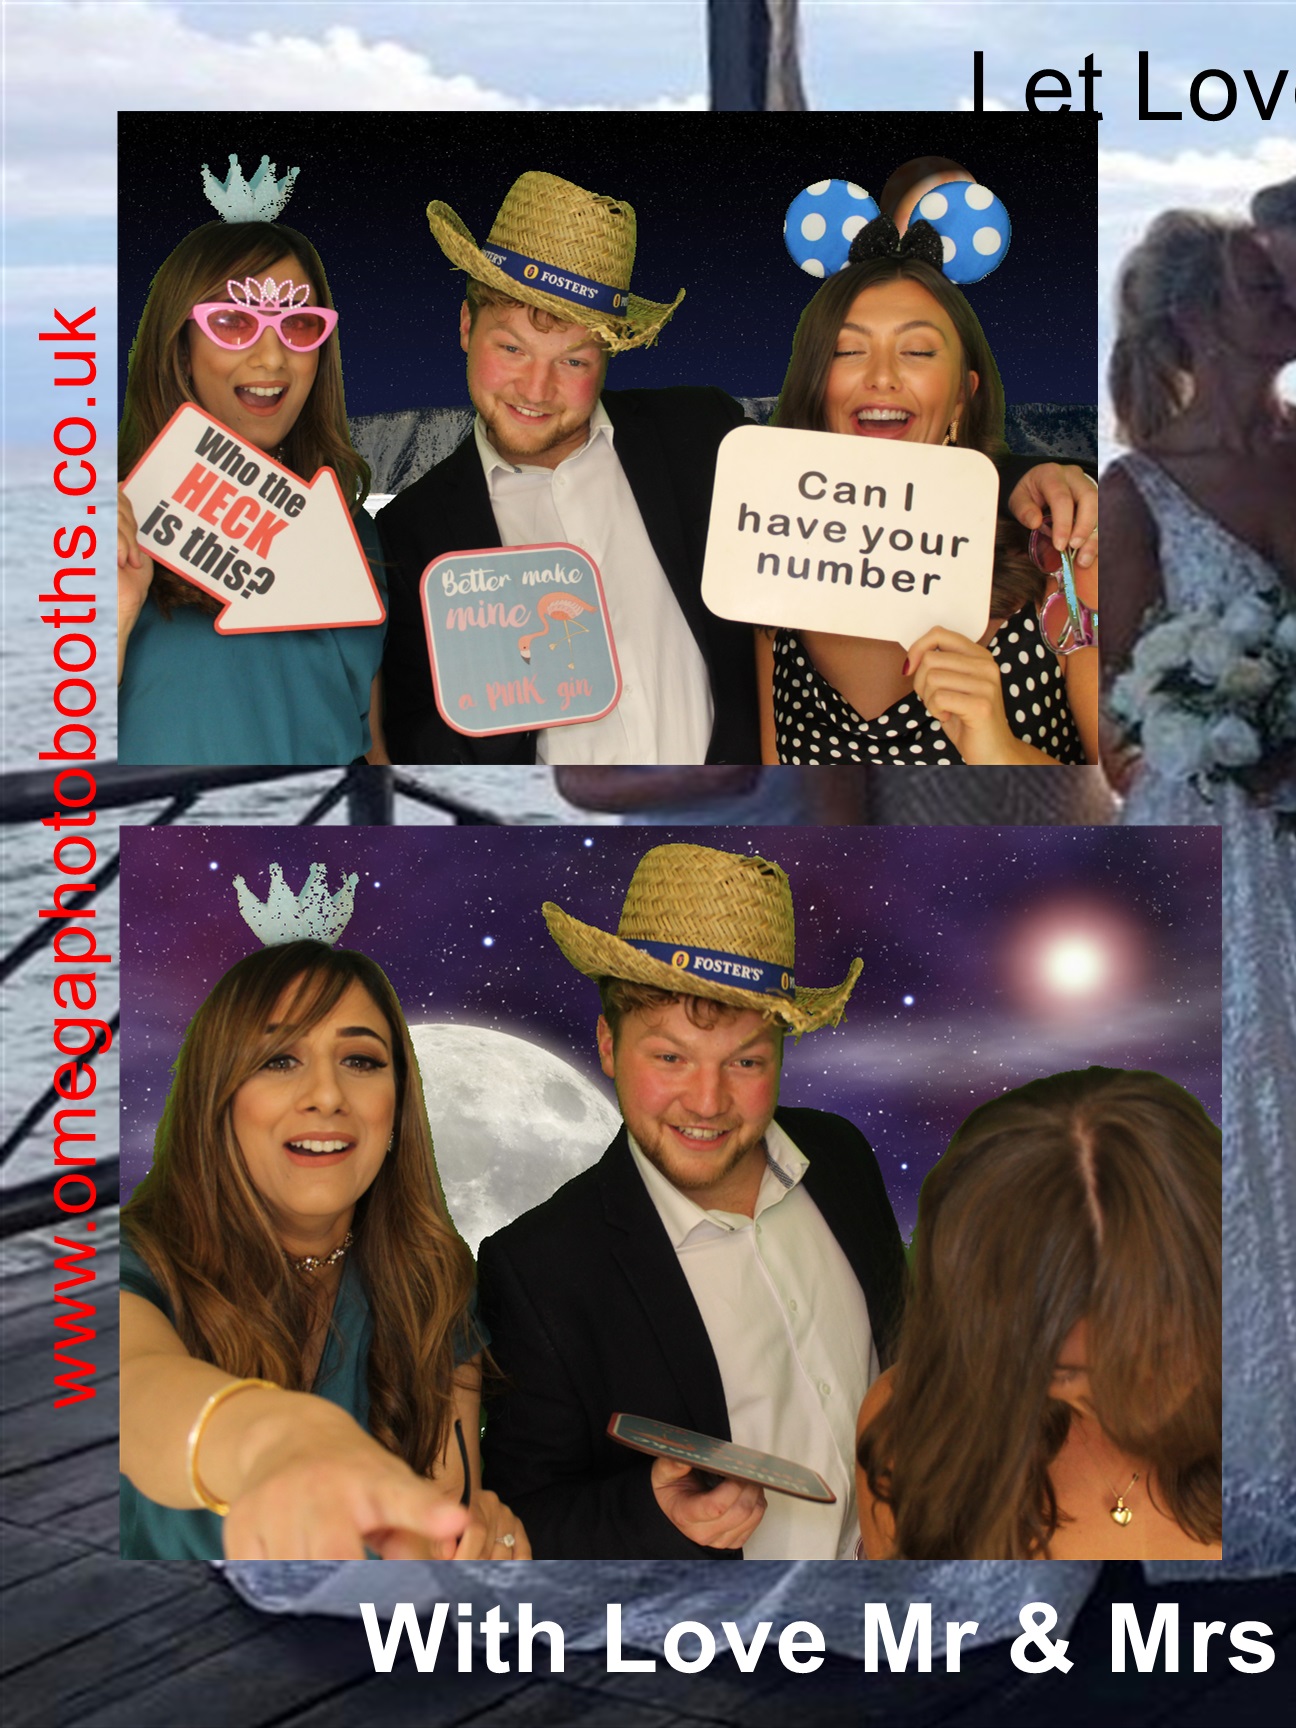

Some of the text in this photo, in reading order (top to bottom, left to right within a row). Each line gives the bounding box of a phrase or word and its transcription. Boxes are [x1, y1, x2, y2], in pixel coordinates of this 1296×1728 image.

[540, 271, 598, 299] FOSTER'S
[194, 426, 307, 518] Who the
[798, 470, 914, 512] Can I
[171, 462, 289, 560] HECK
[737, 502, 970, 558] have your
[139, 500, 276, 600] is this?
[442, 563, 583, 596] Better make
[757, 552, 942, 596] number
[446, 600, 531, 632] mine
[458, 694, 477, 710] a
[557, 677, 593, 711] gin
[693, 956, 764, 982] FOSTER'S
